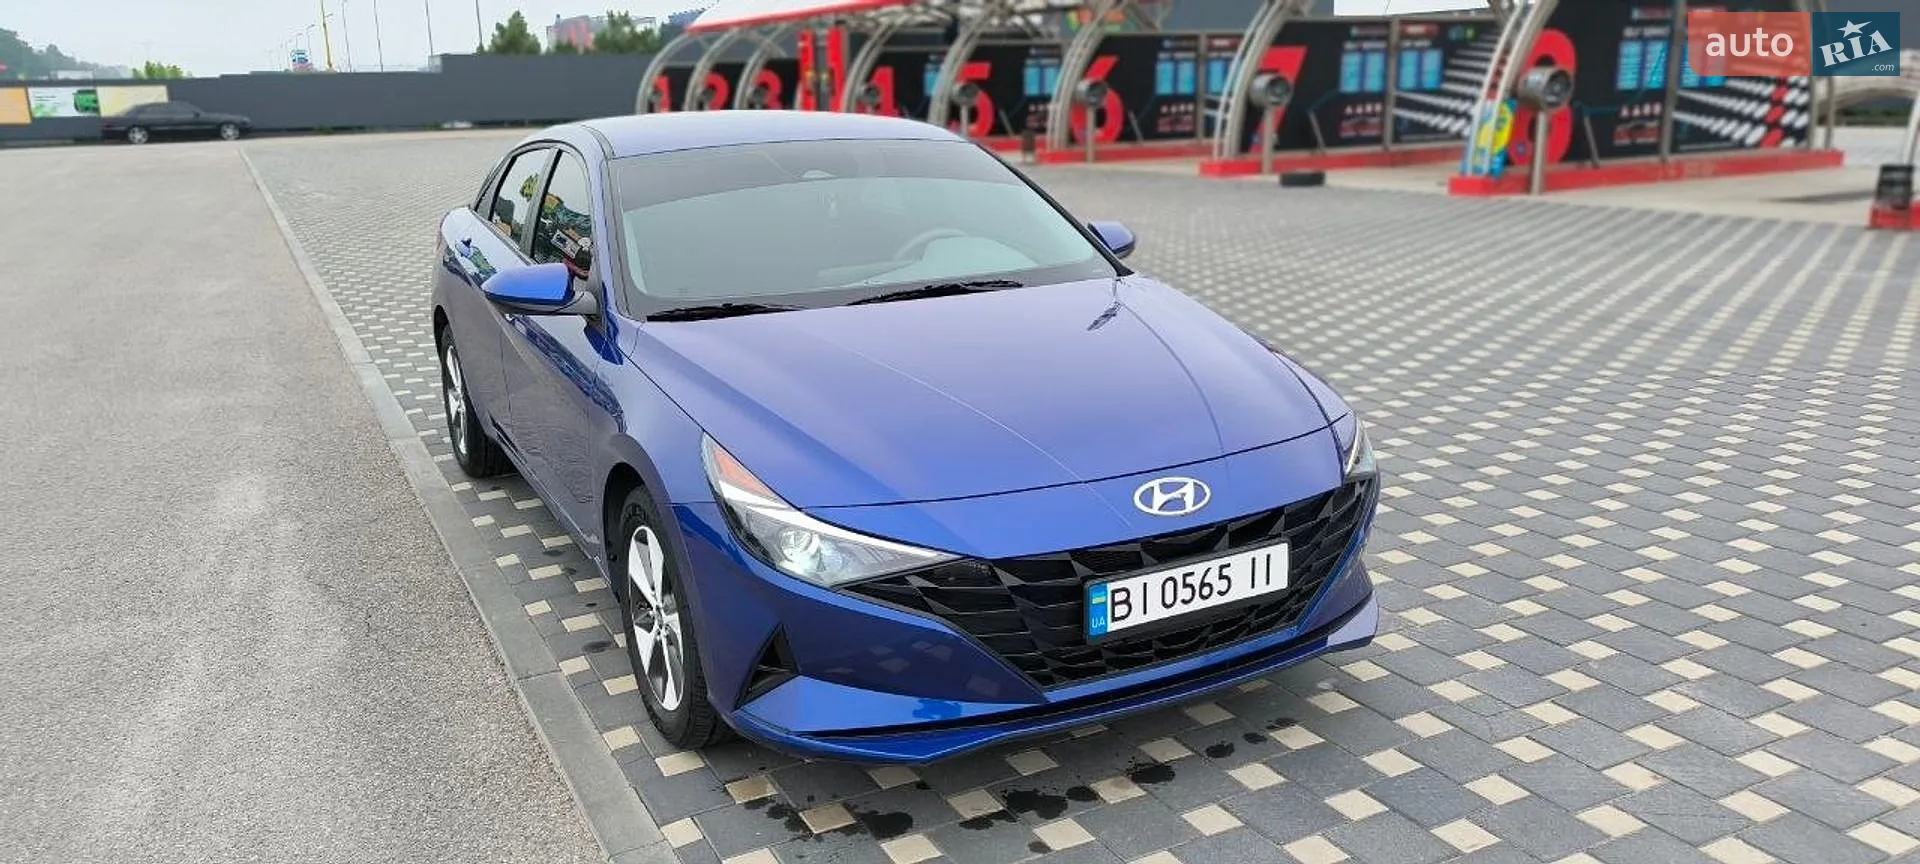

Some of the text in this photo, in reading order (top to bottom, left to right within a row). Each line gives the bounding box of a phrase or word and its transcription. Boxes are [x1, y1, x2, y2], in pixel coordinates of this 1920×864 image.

[1072, 55, 1124, 145] 6
[1250, 46, 1308, 155] 7
[1091, 616, 1106, 629] UA
[1110, 554, 1271, 623] BI 0565 II
